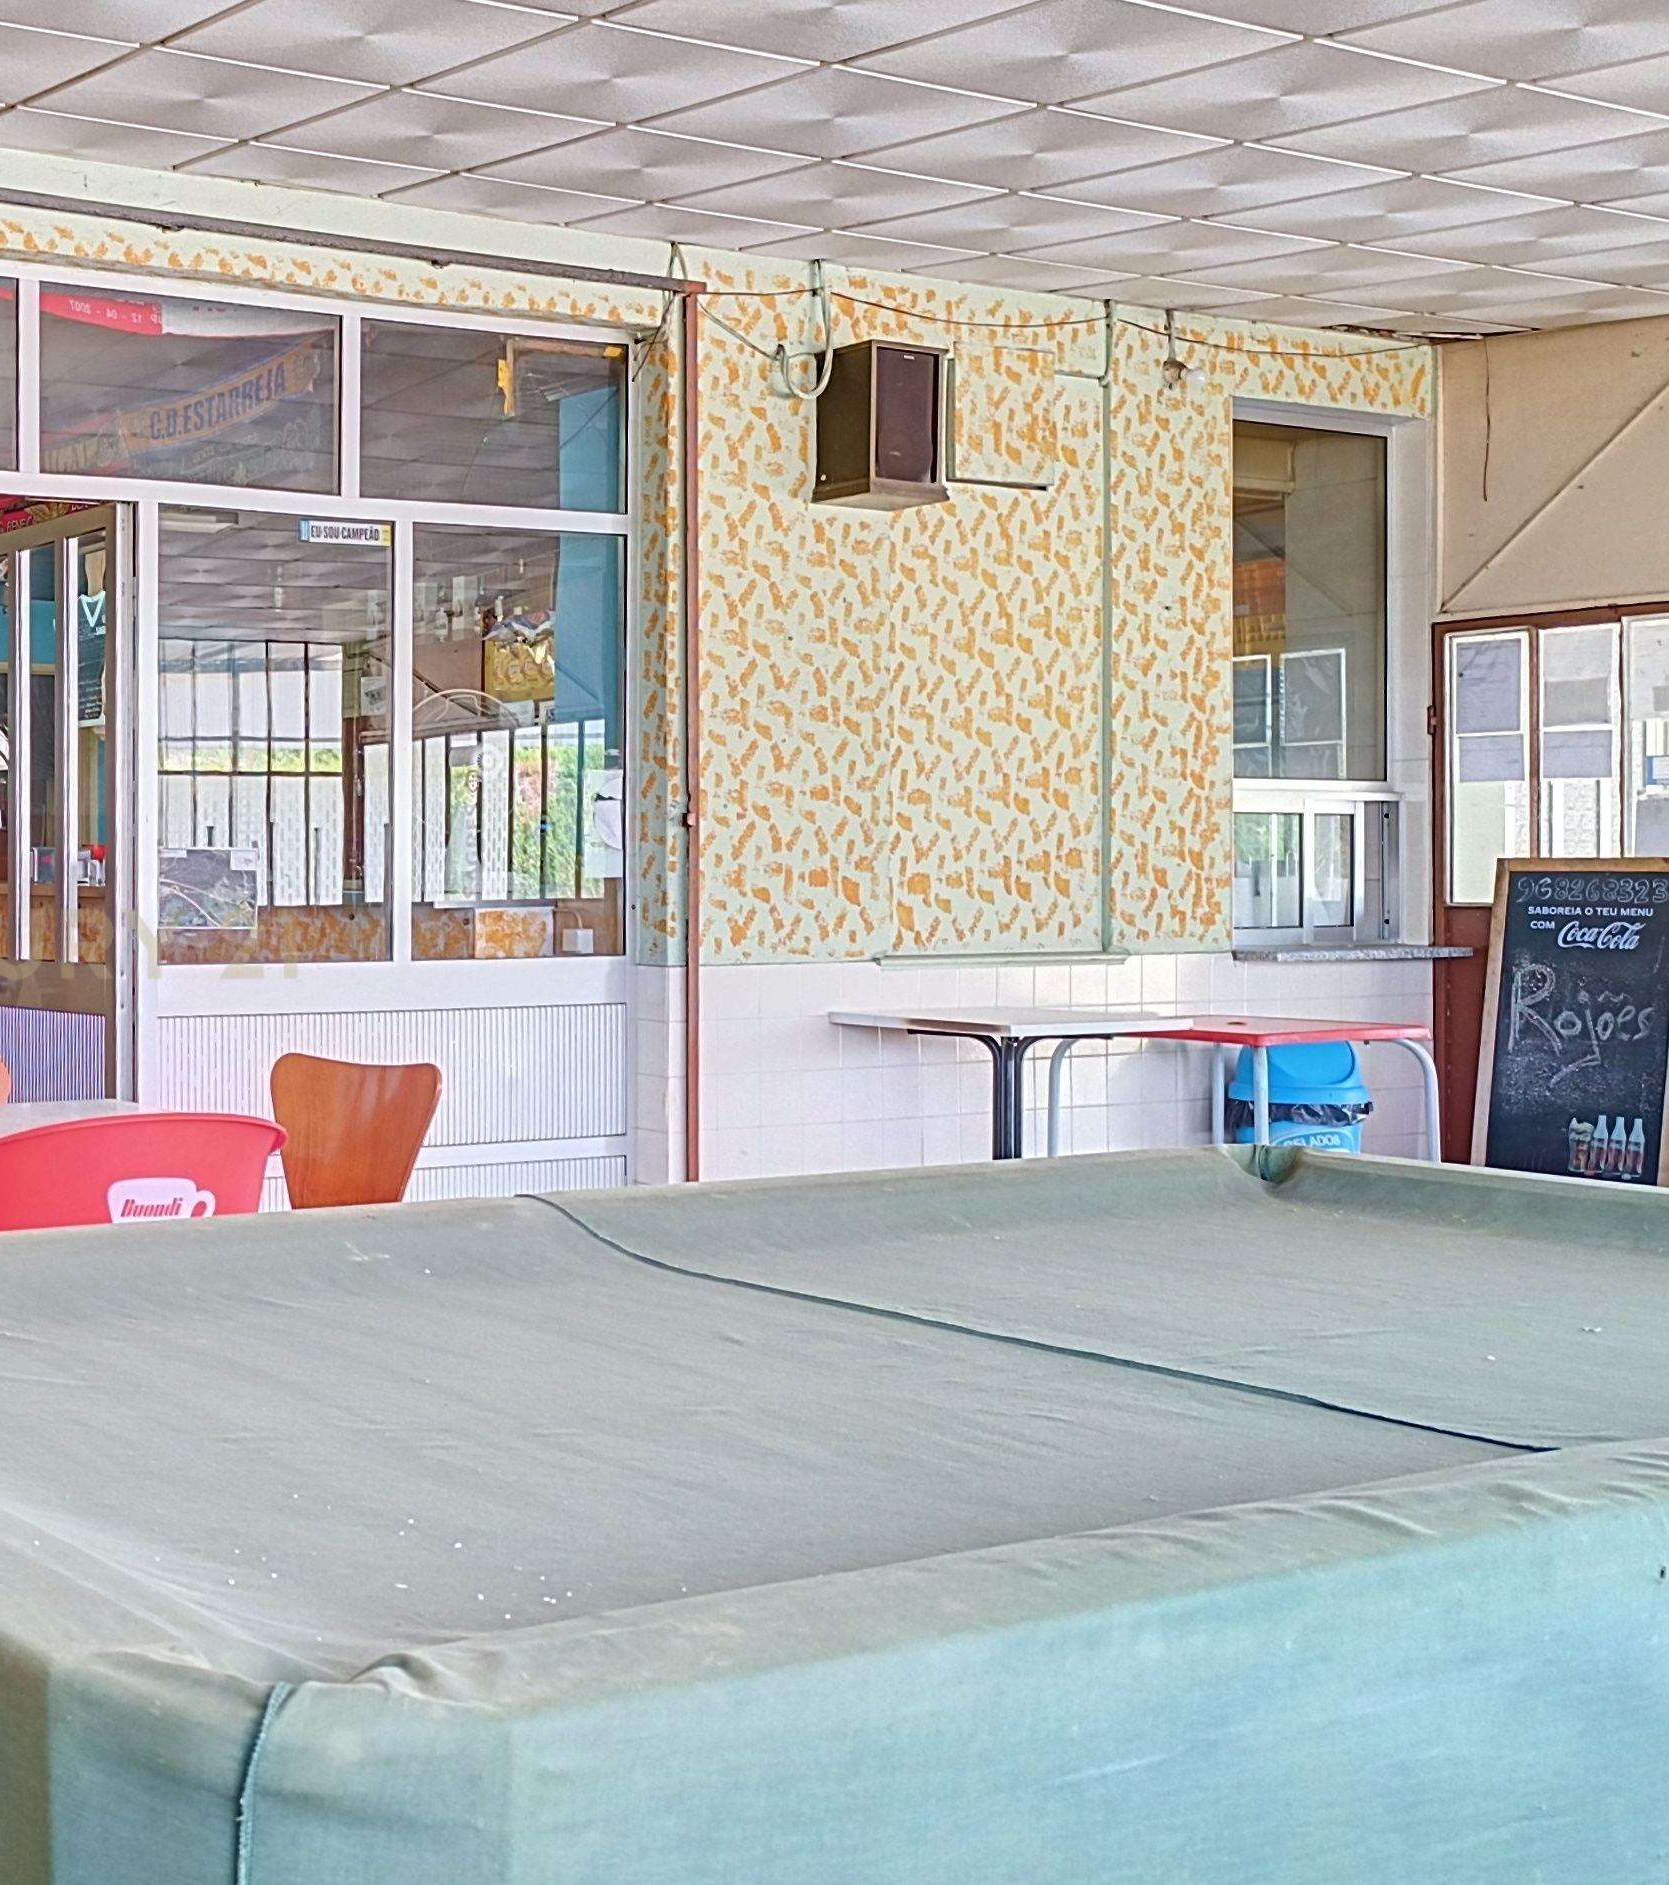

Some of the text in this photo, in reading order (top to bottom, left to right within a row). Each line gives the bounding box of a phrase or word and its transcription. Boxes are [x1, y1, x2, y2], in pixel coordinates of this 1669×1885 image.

[310, 525, 380, 541] EU SOU CAMPEÃO
[1528, 906, 1654, 917] SABOREIA O TEU MENU
[1530, 920, 1647, 950] COM Coca-Cola
[120, 1196, 184, 1218] Buondi
